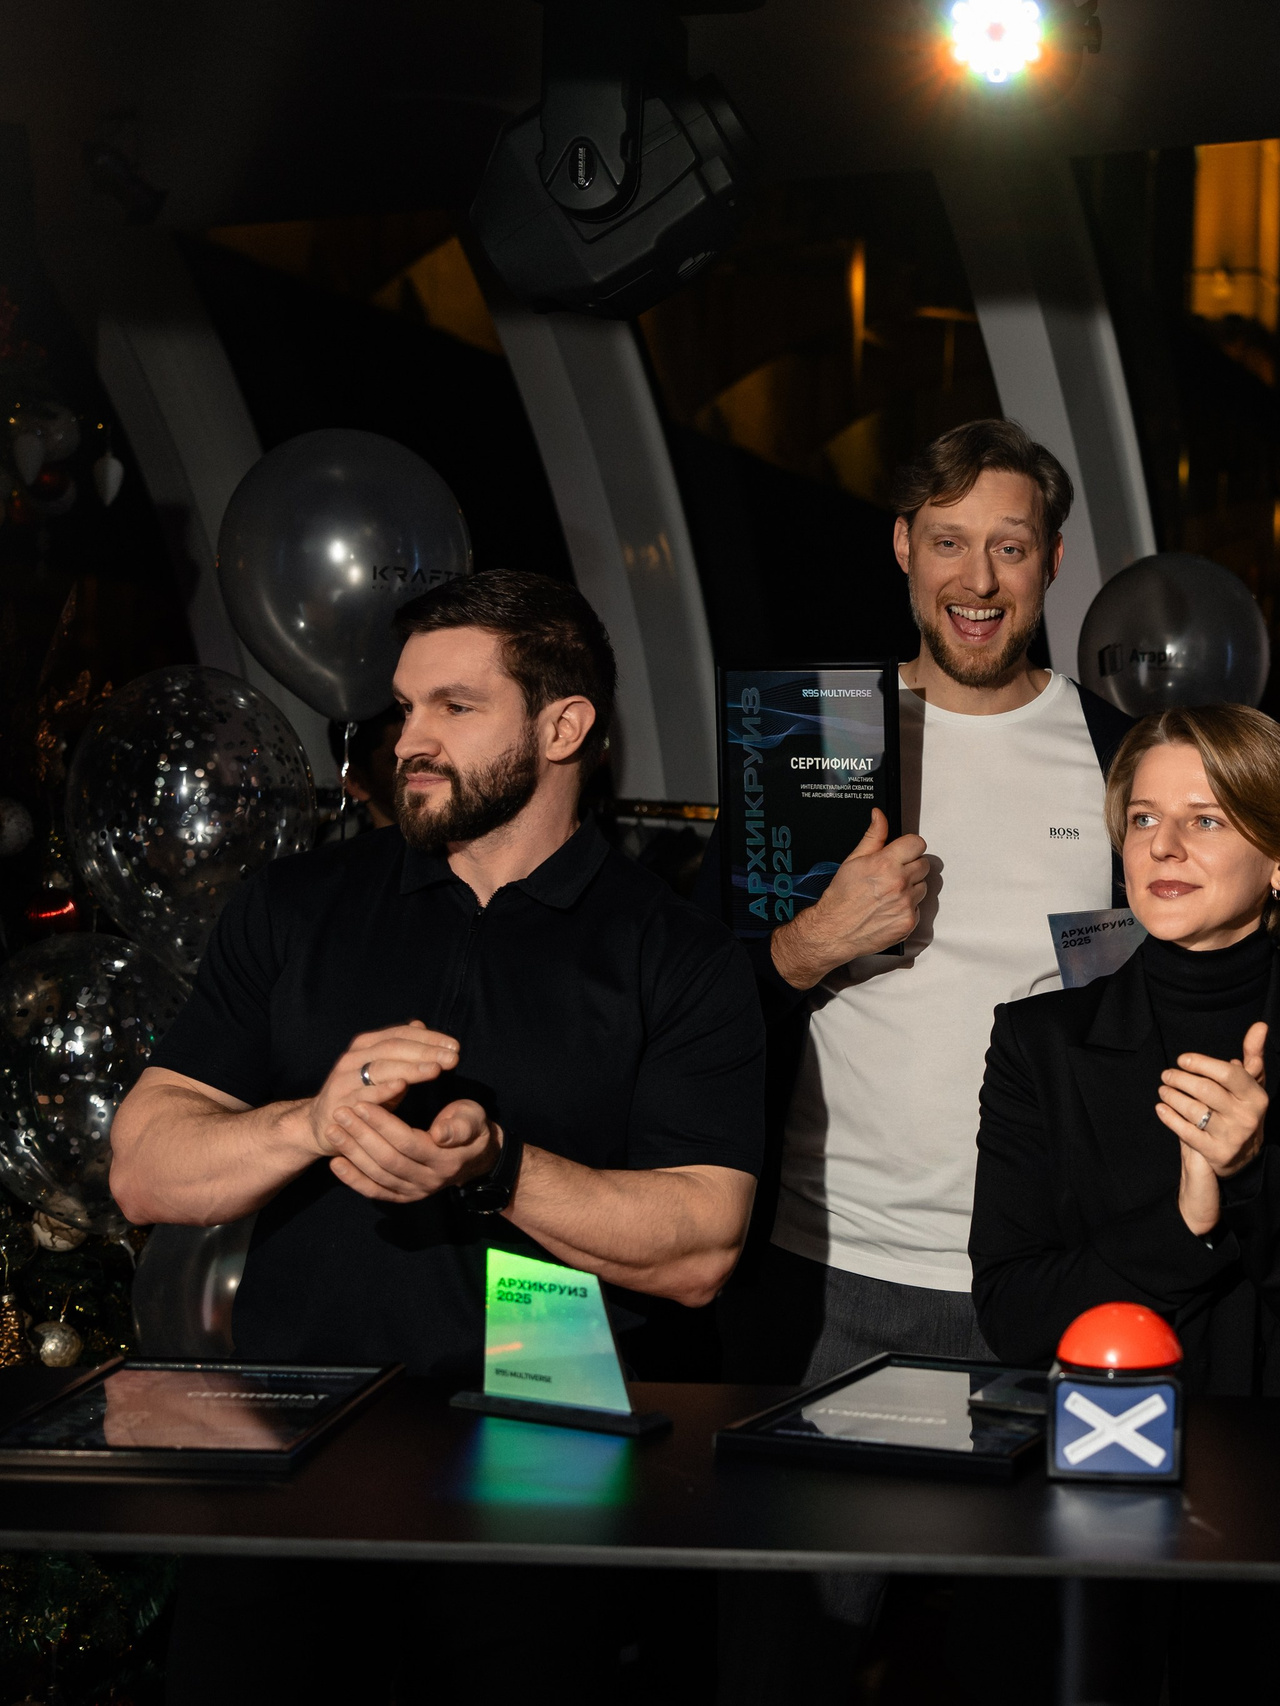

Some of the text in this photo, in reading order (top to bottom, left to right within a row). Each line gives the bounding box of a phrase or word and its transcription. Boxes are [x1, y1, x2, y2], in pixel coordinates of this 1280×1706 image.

[820, 689, 873, 698] MULTIVERSE
[790, 757, 874, 771] СЕРТИФИКАТ
[741, 687, 768, 921] АРХИКРУИЗ
[1049, 827, 1080, 837] BOSS
[772, 825, 794, 921] 2025
[1060, 917, 1135, 939] АРХИКРУИЗ
[1062, 936, 1092, 949] 2025
[498, 1277, 588, 1298] АРХИКРУИЗ
[497, 1289, 532, 1304] 2025
